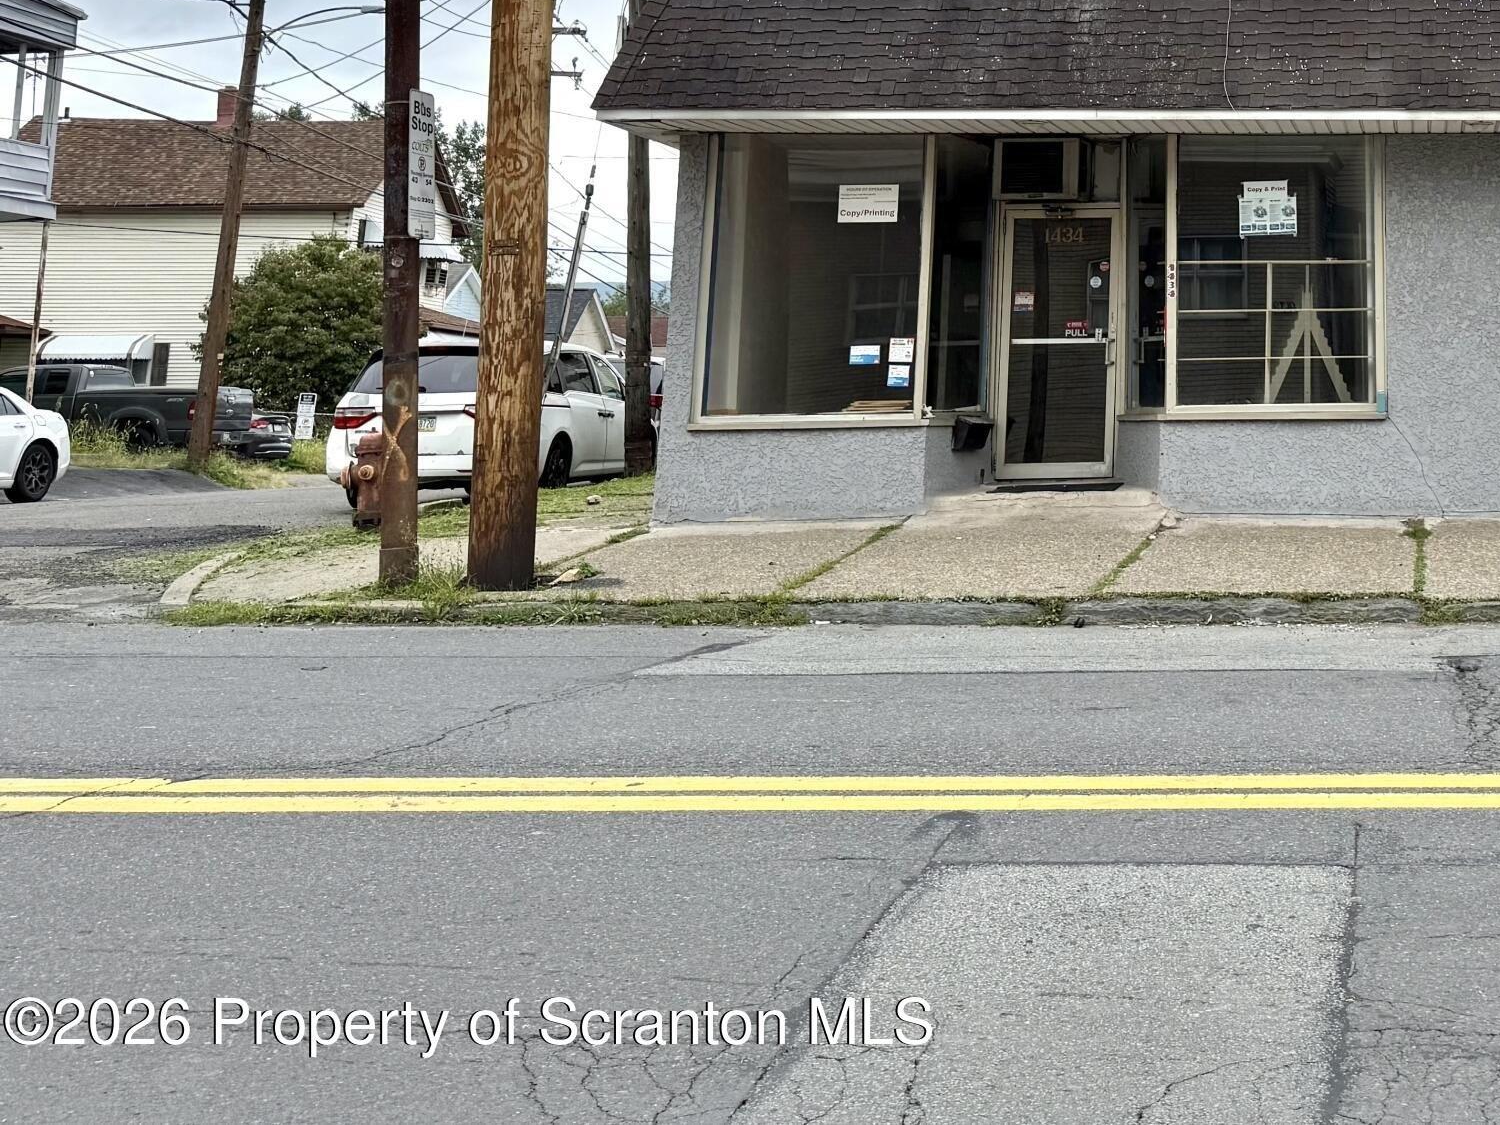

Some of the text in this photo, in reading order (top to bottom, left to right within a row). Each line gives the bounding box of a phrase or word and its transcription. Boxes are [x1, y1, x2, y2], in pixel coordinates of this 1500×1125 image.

[413, 100, 431, 118] Bus
[411, 116, 434, 136] Stop
[840, 209, 895, 218] Copy/Printing
[1044, 227, 1084, 244] 1434
[1065, 329, 1088, 337] PULL
